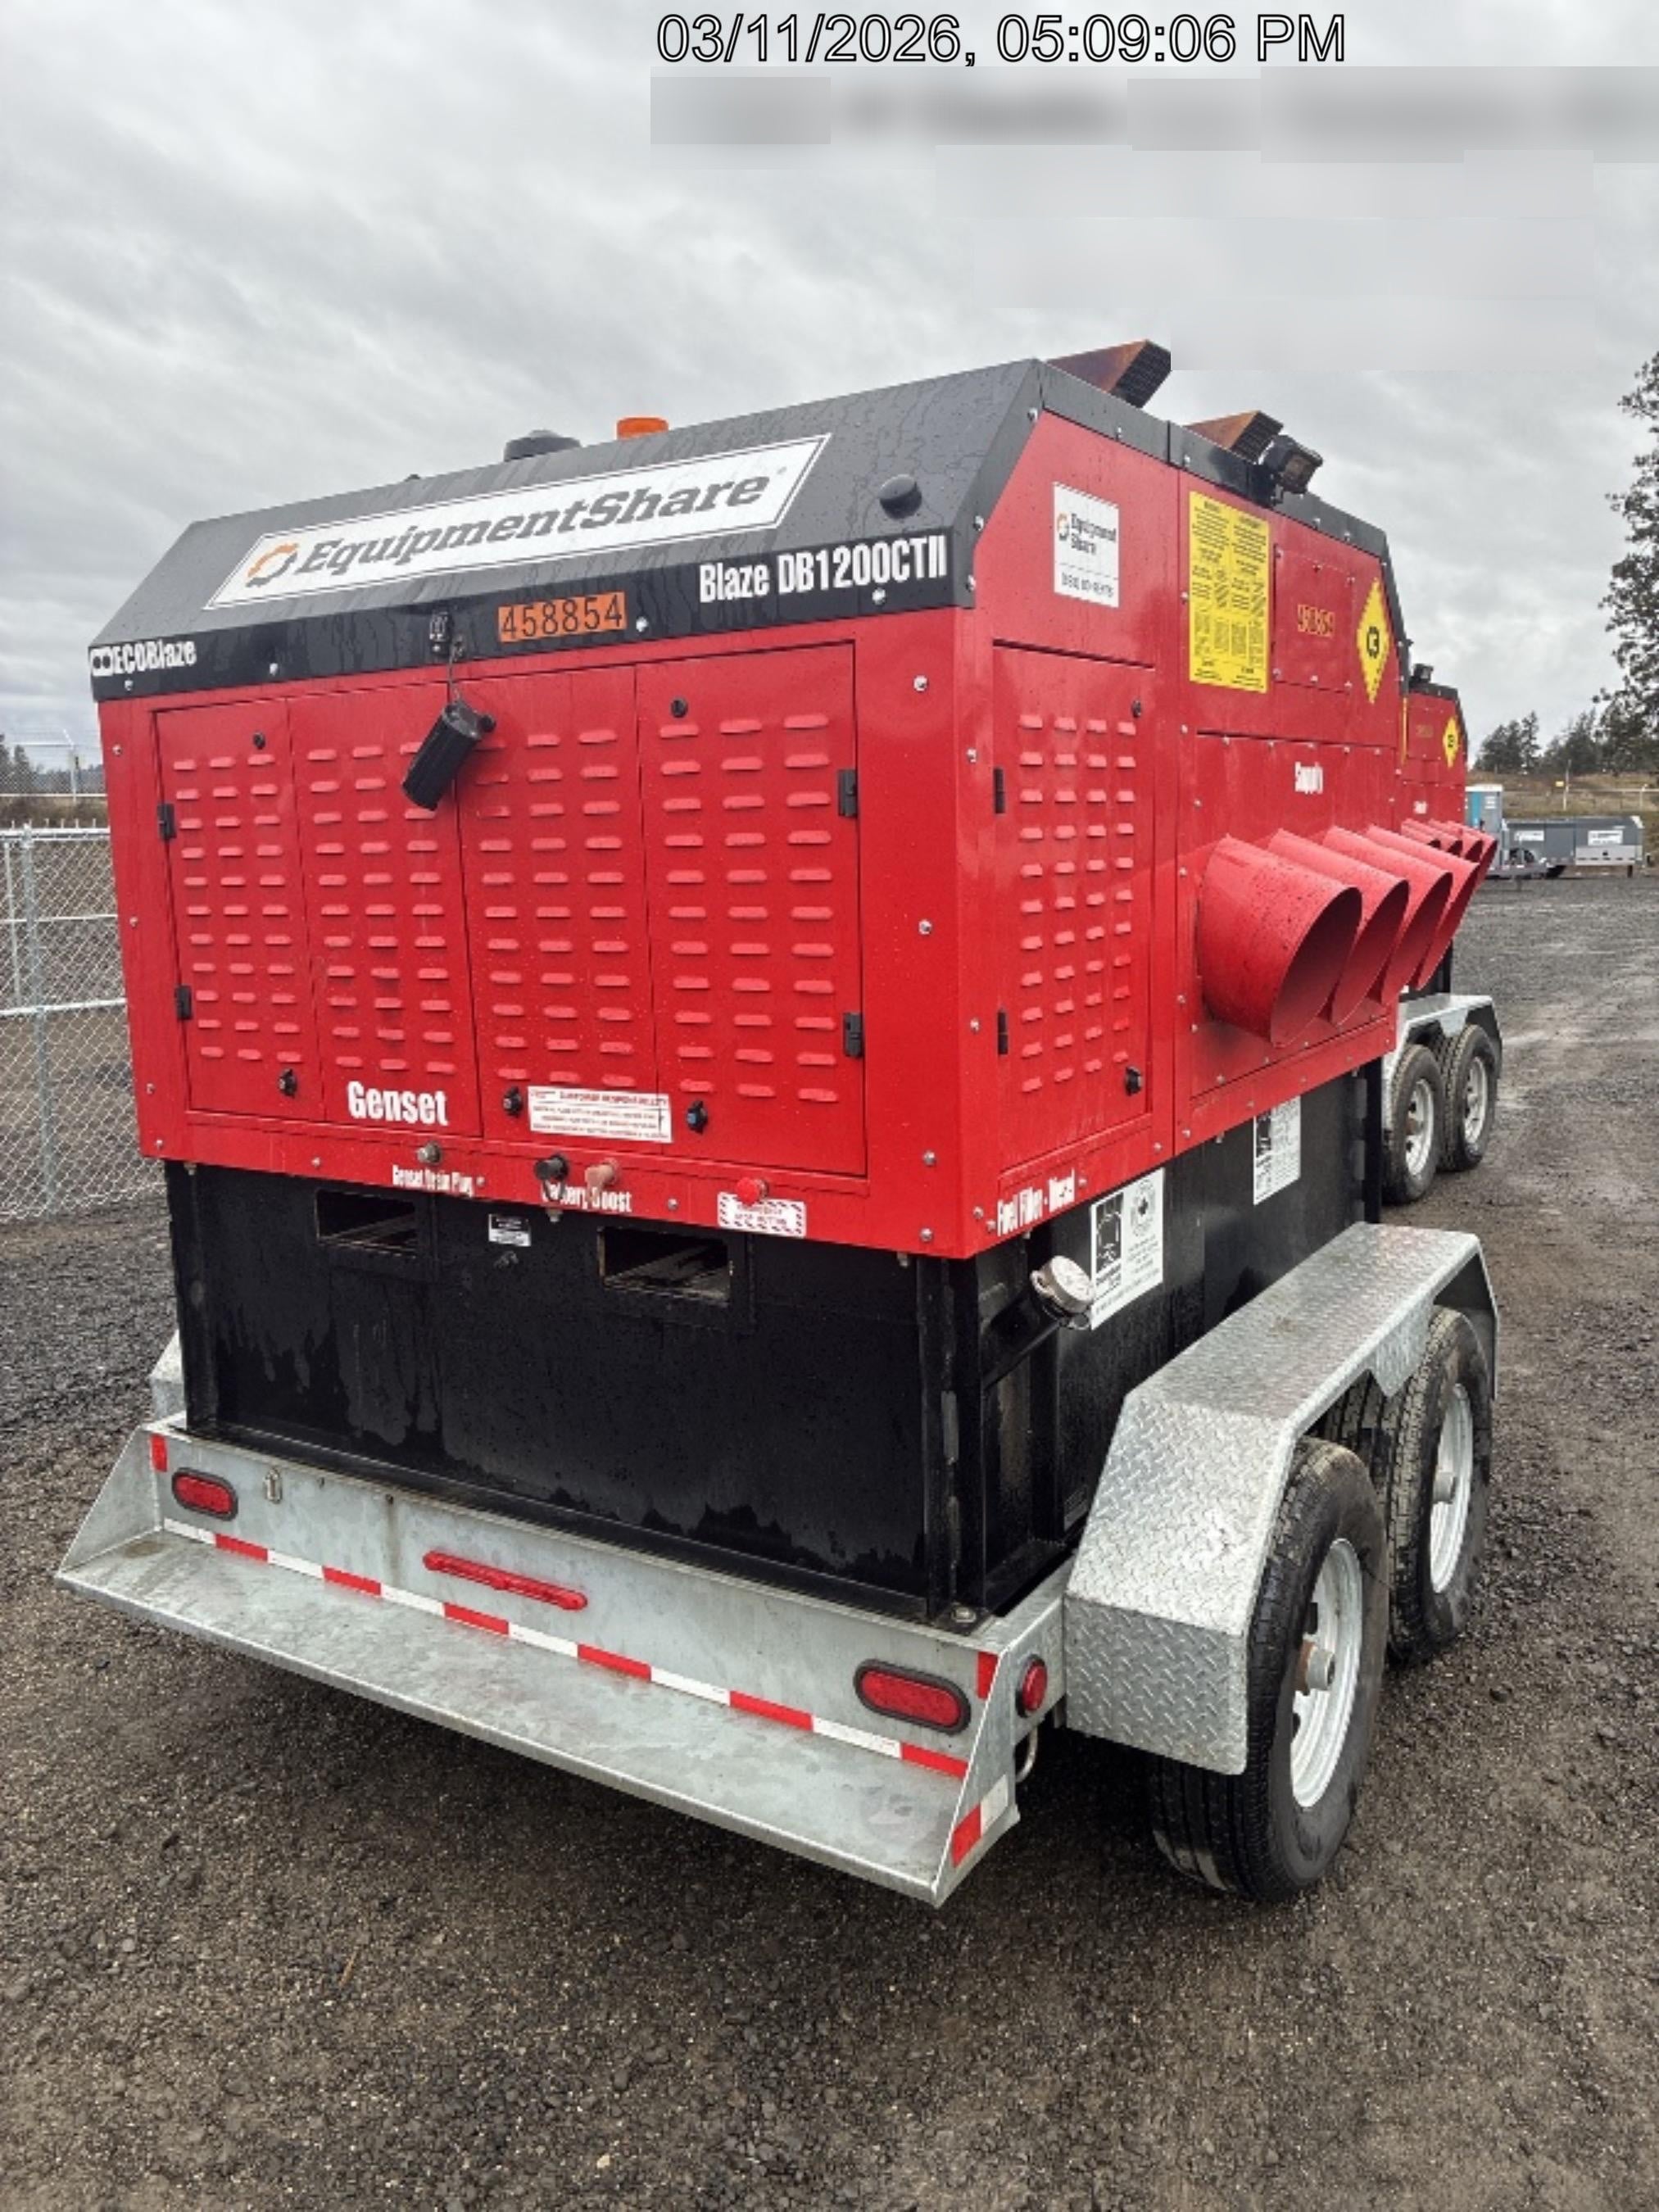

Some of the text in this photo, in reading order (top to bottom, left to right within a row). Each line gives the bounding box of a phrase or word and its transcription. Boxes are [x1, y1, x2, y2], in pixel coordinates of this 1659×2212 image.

[296, 474, 772, 575] EquipmentShare
[699, 562, 770, 603] Blaze
[501, 594, 623, 639] 458854
[347, 1081, 448, 1126] Genset
